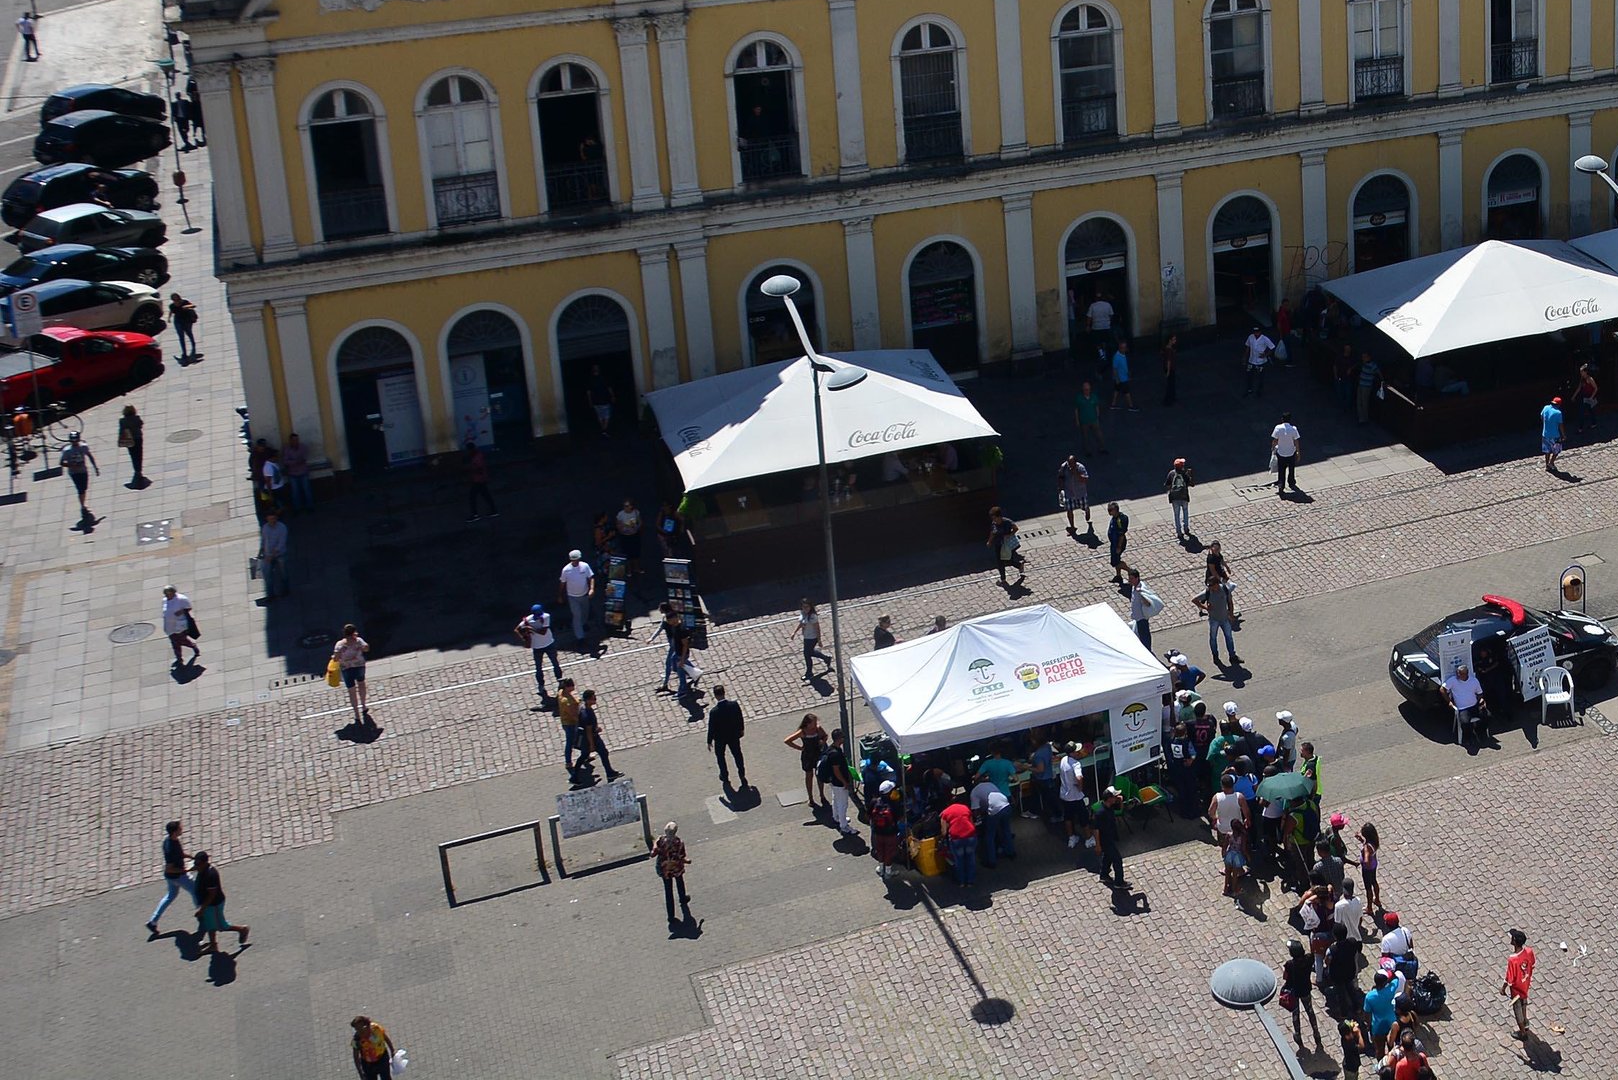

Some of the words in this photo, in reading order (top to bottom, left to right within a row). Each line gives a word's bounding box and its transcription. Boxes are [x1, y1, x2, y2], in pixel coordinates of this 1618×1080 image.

[1544, 296, 1599, 321] Coca-Cola
[849, 420, 918, 448] Coca-Cola
[1041, 652, 1079, 668] PREFEITURA
[1044, 658, 1083, 676] PORTO
[1047, 667, 1086, 684] ALEGRE
